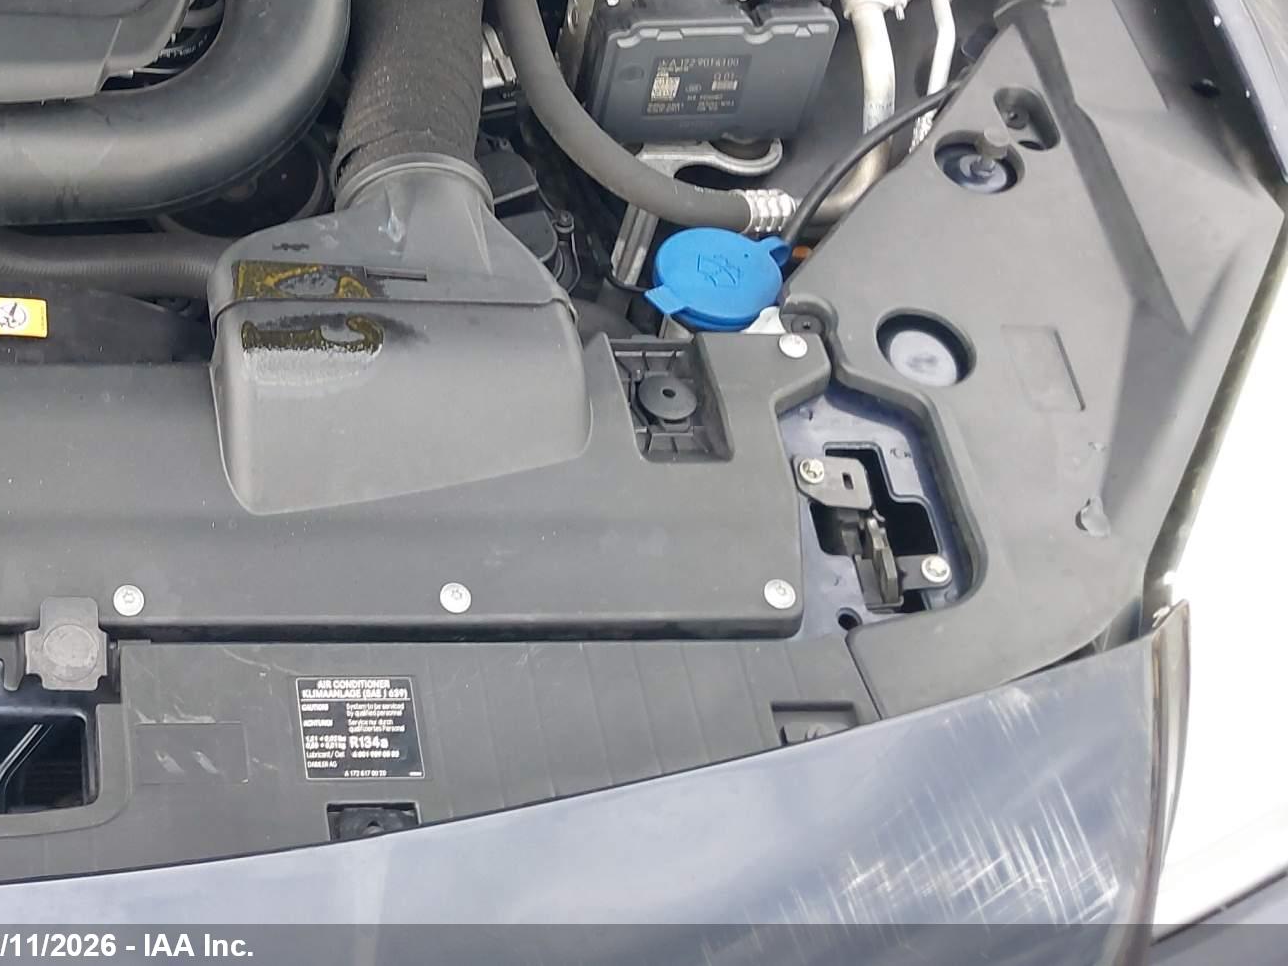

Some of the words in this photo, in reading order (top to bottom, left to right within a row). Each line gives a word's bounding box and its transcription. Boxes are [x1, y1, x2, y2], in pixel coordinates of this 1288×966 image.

[317, 679, 332, 689] AIR
[332, 679, 391, 689] CONDITIONER
[302, 689, 362, 699] KLIMAANLAGE
[348, 735, 389, 749] R134a
